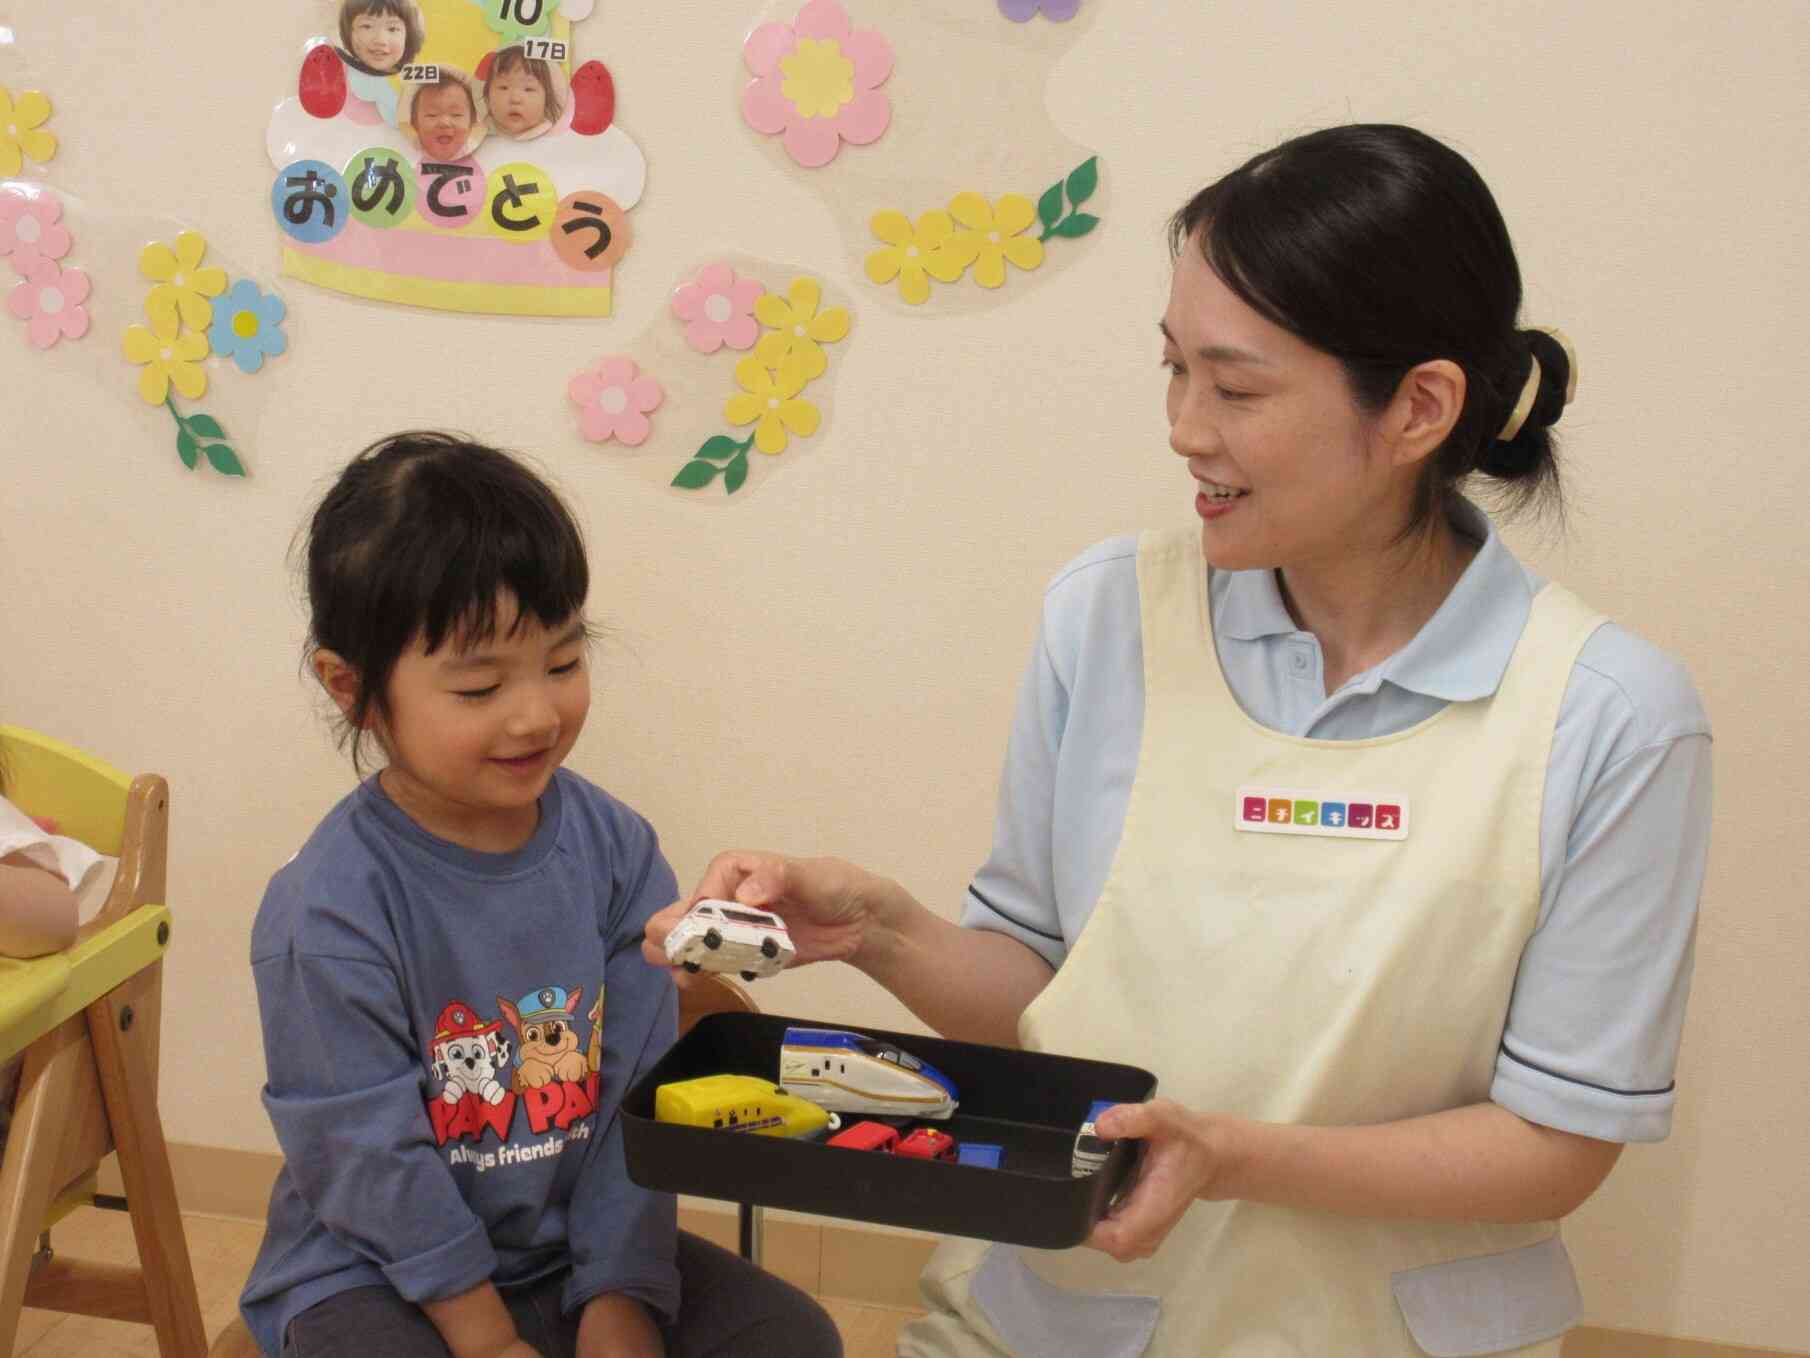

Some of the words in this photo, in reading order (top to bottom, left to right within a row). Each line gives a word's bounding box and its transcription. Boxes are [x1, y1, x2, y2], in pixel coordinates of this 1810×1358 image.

[526, 40, 566, 60] 17日
[403, 65, 437, 80] 22日
[283, 157, 612, 260] おめでとう
[429, 1091, 517, 1148] PAW
